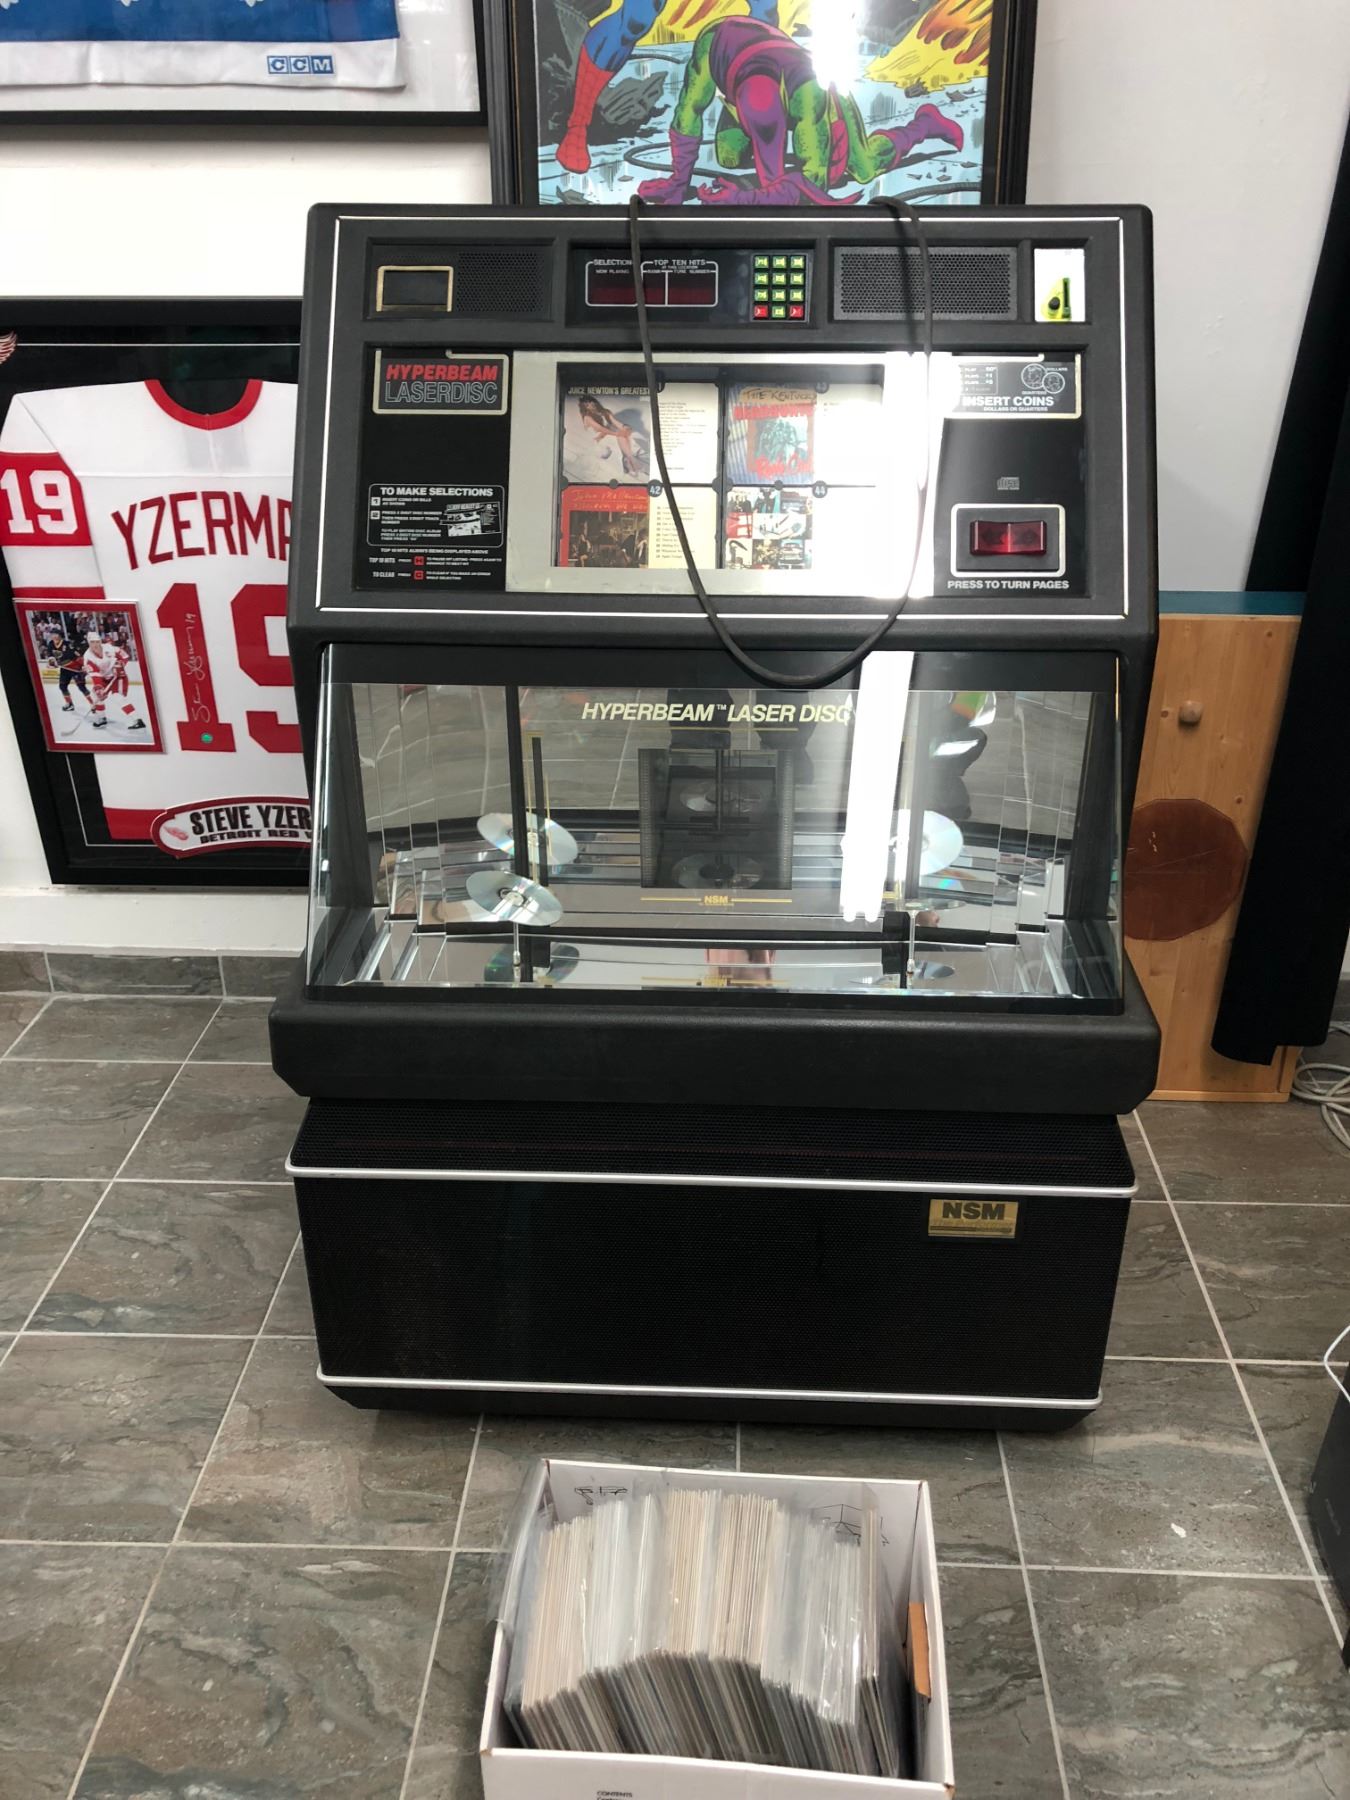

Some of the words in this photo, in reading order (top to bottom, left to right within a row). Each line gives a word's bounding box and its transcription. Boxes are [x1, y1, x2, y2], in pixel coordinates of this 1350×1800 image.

[267, 55, 335, 75] CCM
[385, 363, 498, 381] HYPERBEAM
[384, 381, 498, 404] LASERDISC
[962, 396, 1011, 406] INSERT
[1013, 396, 1054, 406] COINS
[380, 487, 396, 496] TO
[396, 487, 428, 496] MAKE
[428, 487, 494, 497] SELECTIONS
[649, 486, 661, 495] 42
[814, 486, 825, 495] 44
[0, 469, 78, 535] 19
[947, 580, 983, 589] PRESS
[984, 580, 1000, 589] TO
[1001, 580, 1031, 589] TURN
[1033, 580, 1069, 589] PAGES
[727, 703, 795, 722] LASER
[799, 703, 853, 724] DISC
[190, 806, 253, 835] STEVE
[199, 829, 262, 844] DETROIT
[268, 829, 300, 838] RED
[704, 895, 728, 904] NSM
[942, 1201, 1005, 1221] NSM
